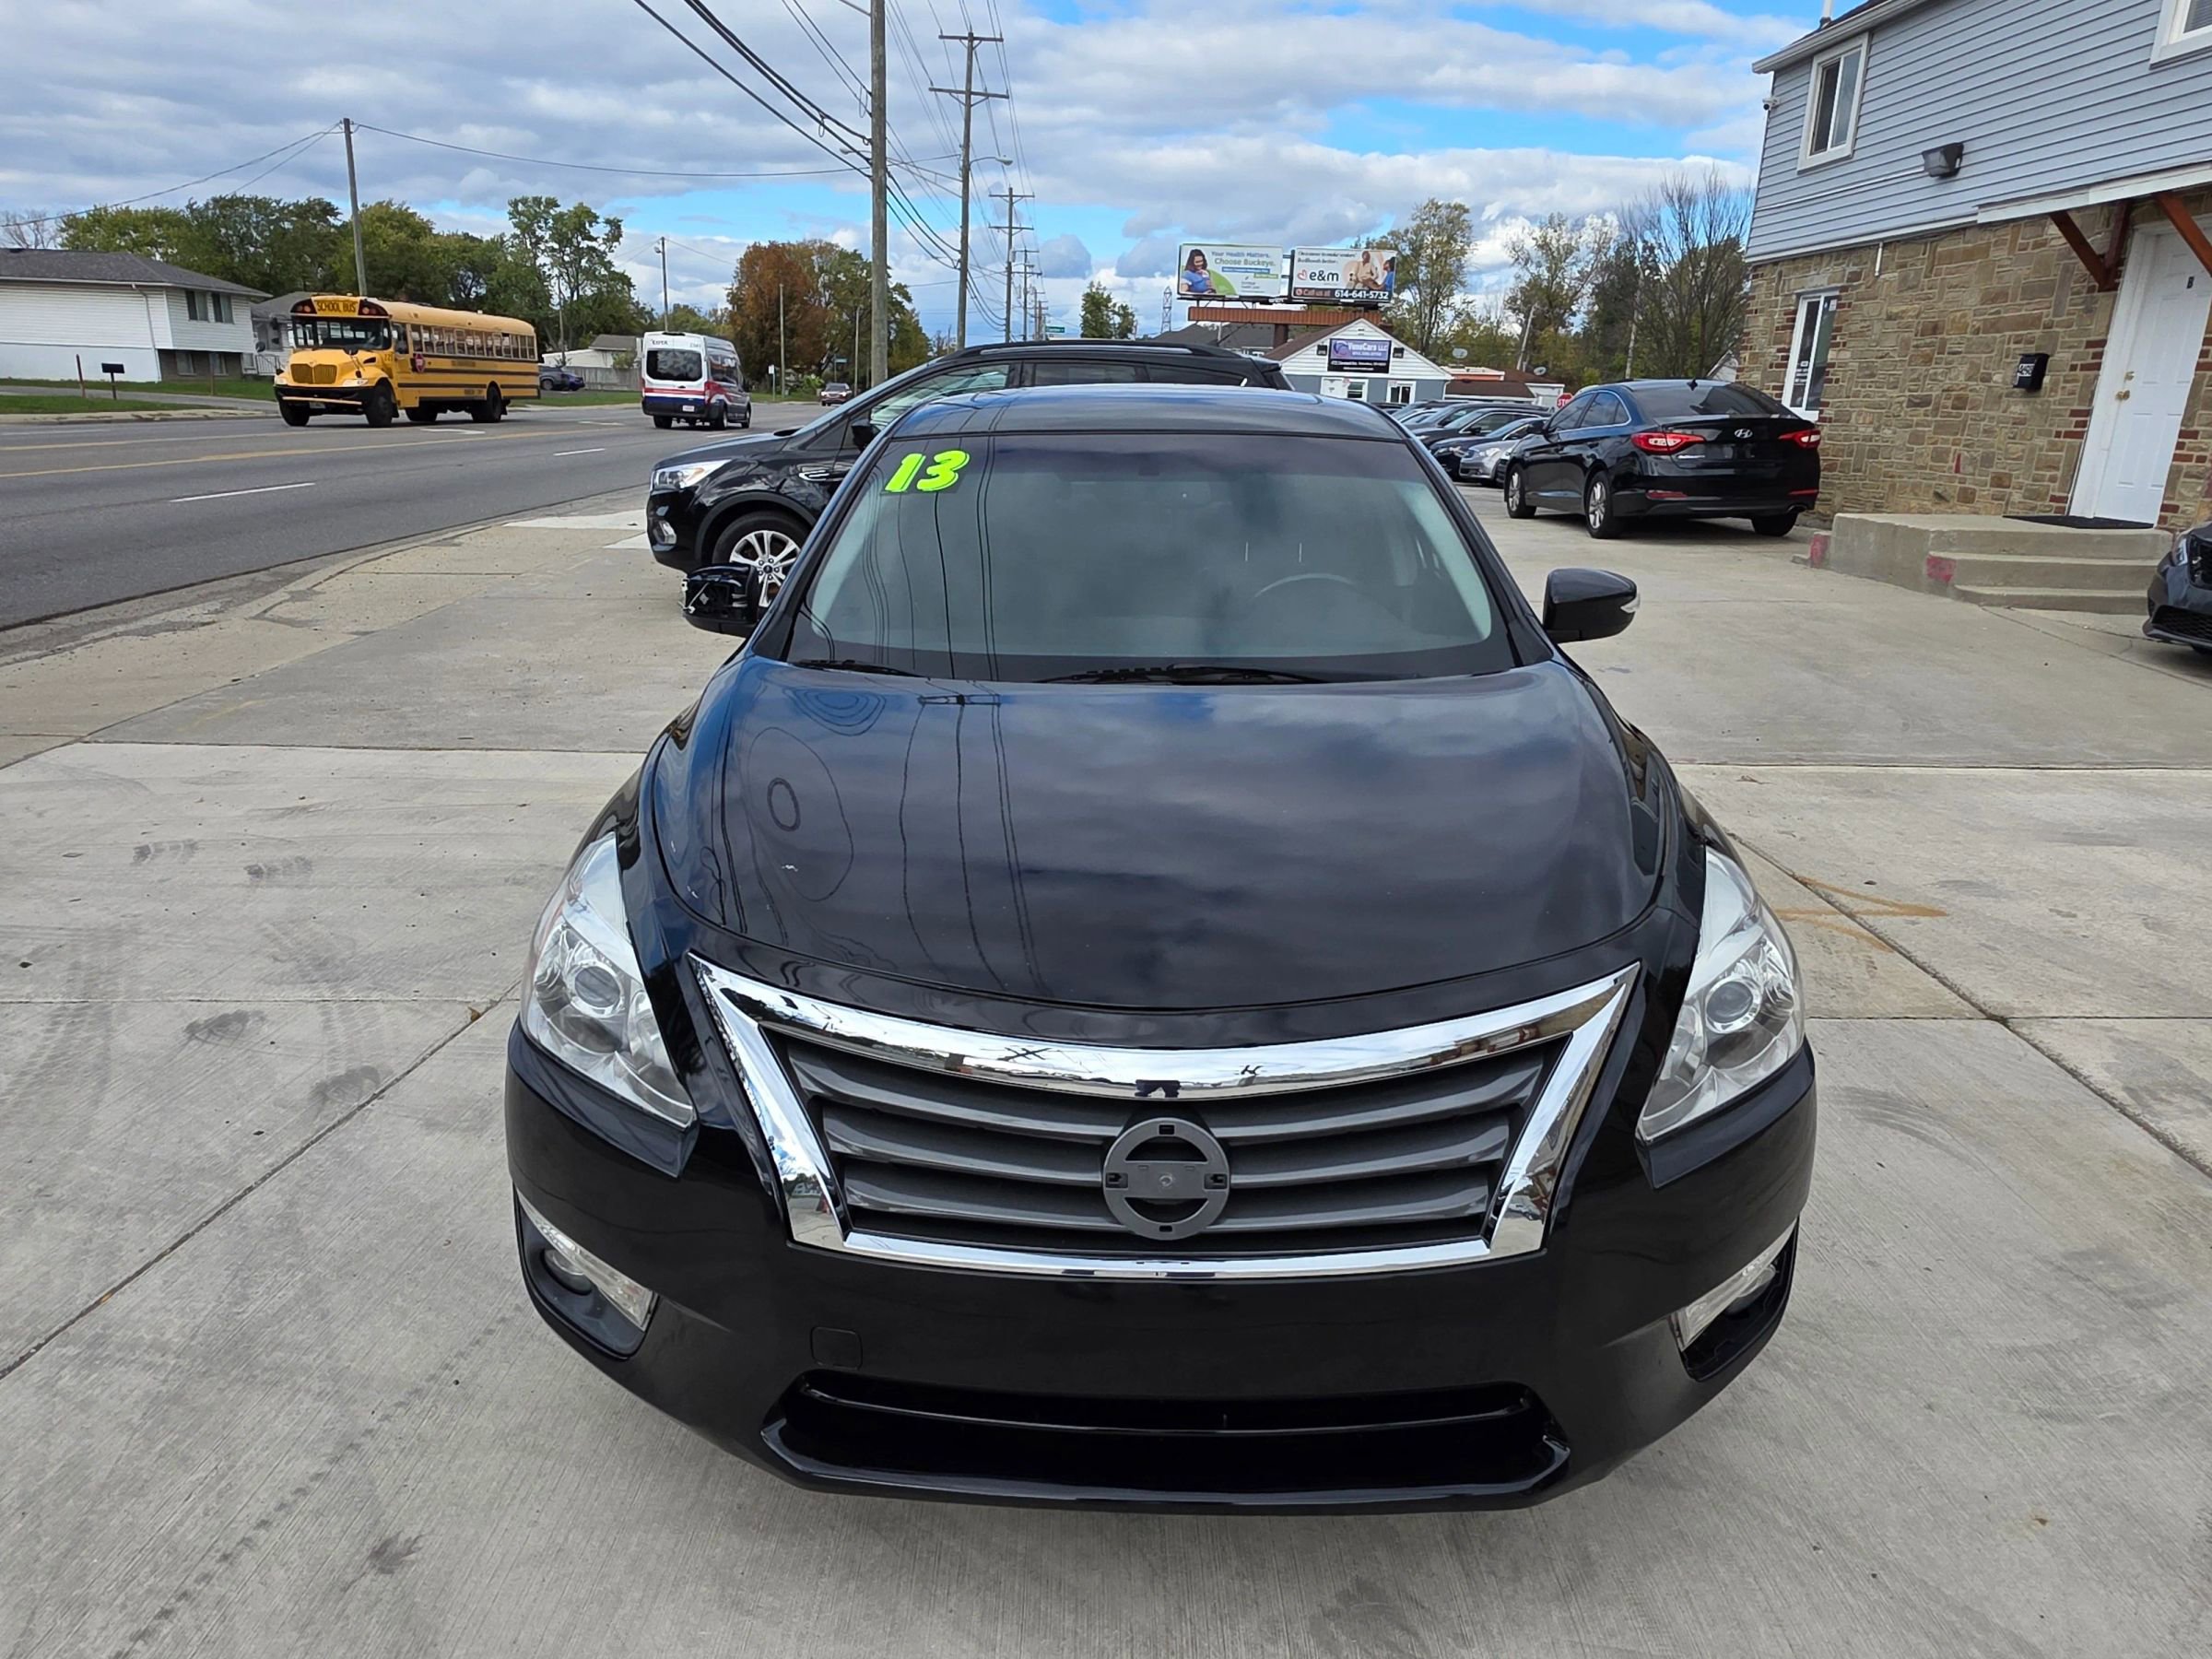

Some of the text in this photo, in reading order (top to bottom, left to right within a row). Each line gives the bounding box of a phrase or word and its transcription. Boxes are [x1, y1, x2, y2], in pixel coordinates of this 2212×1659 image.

[1309, 269, 1339, 282] e&m
[317, 300, 356, 313] SCHOOL BUS
[885, 449, 971, 493] 13
